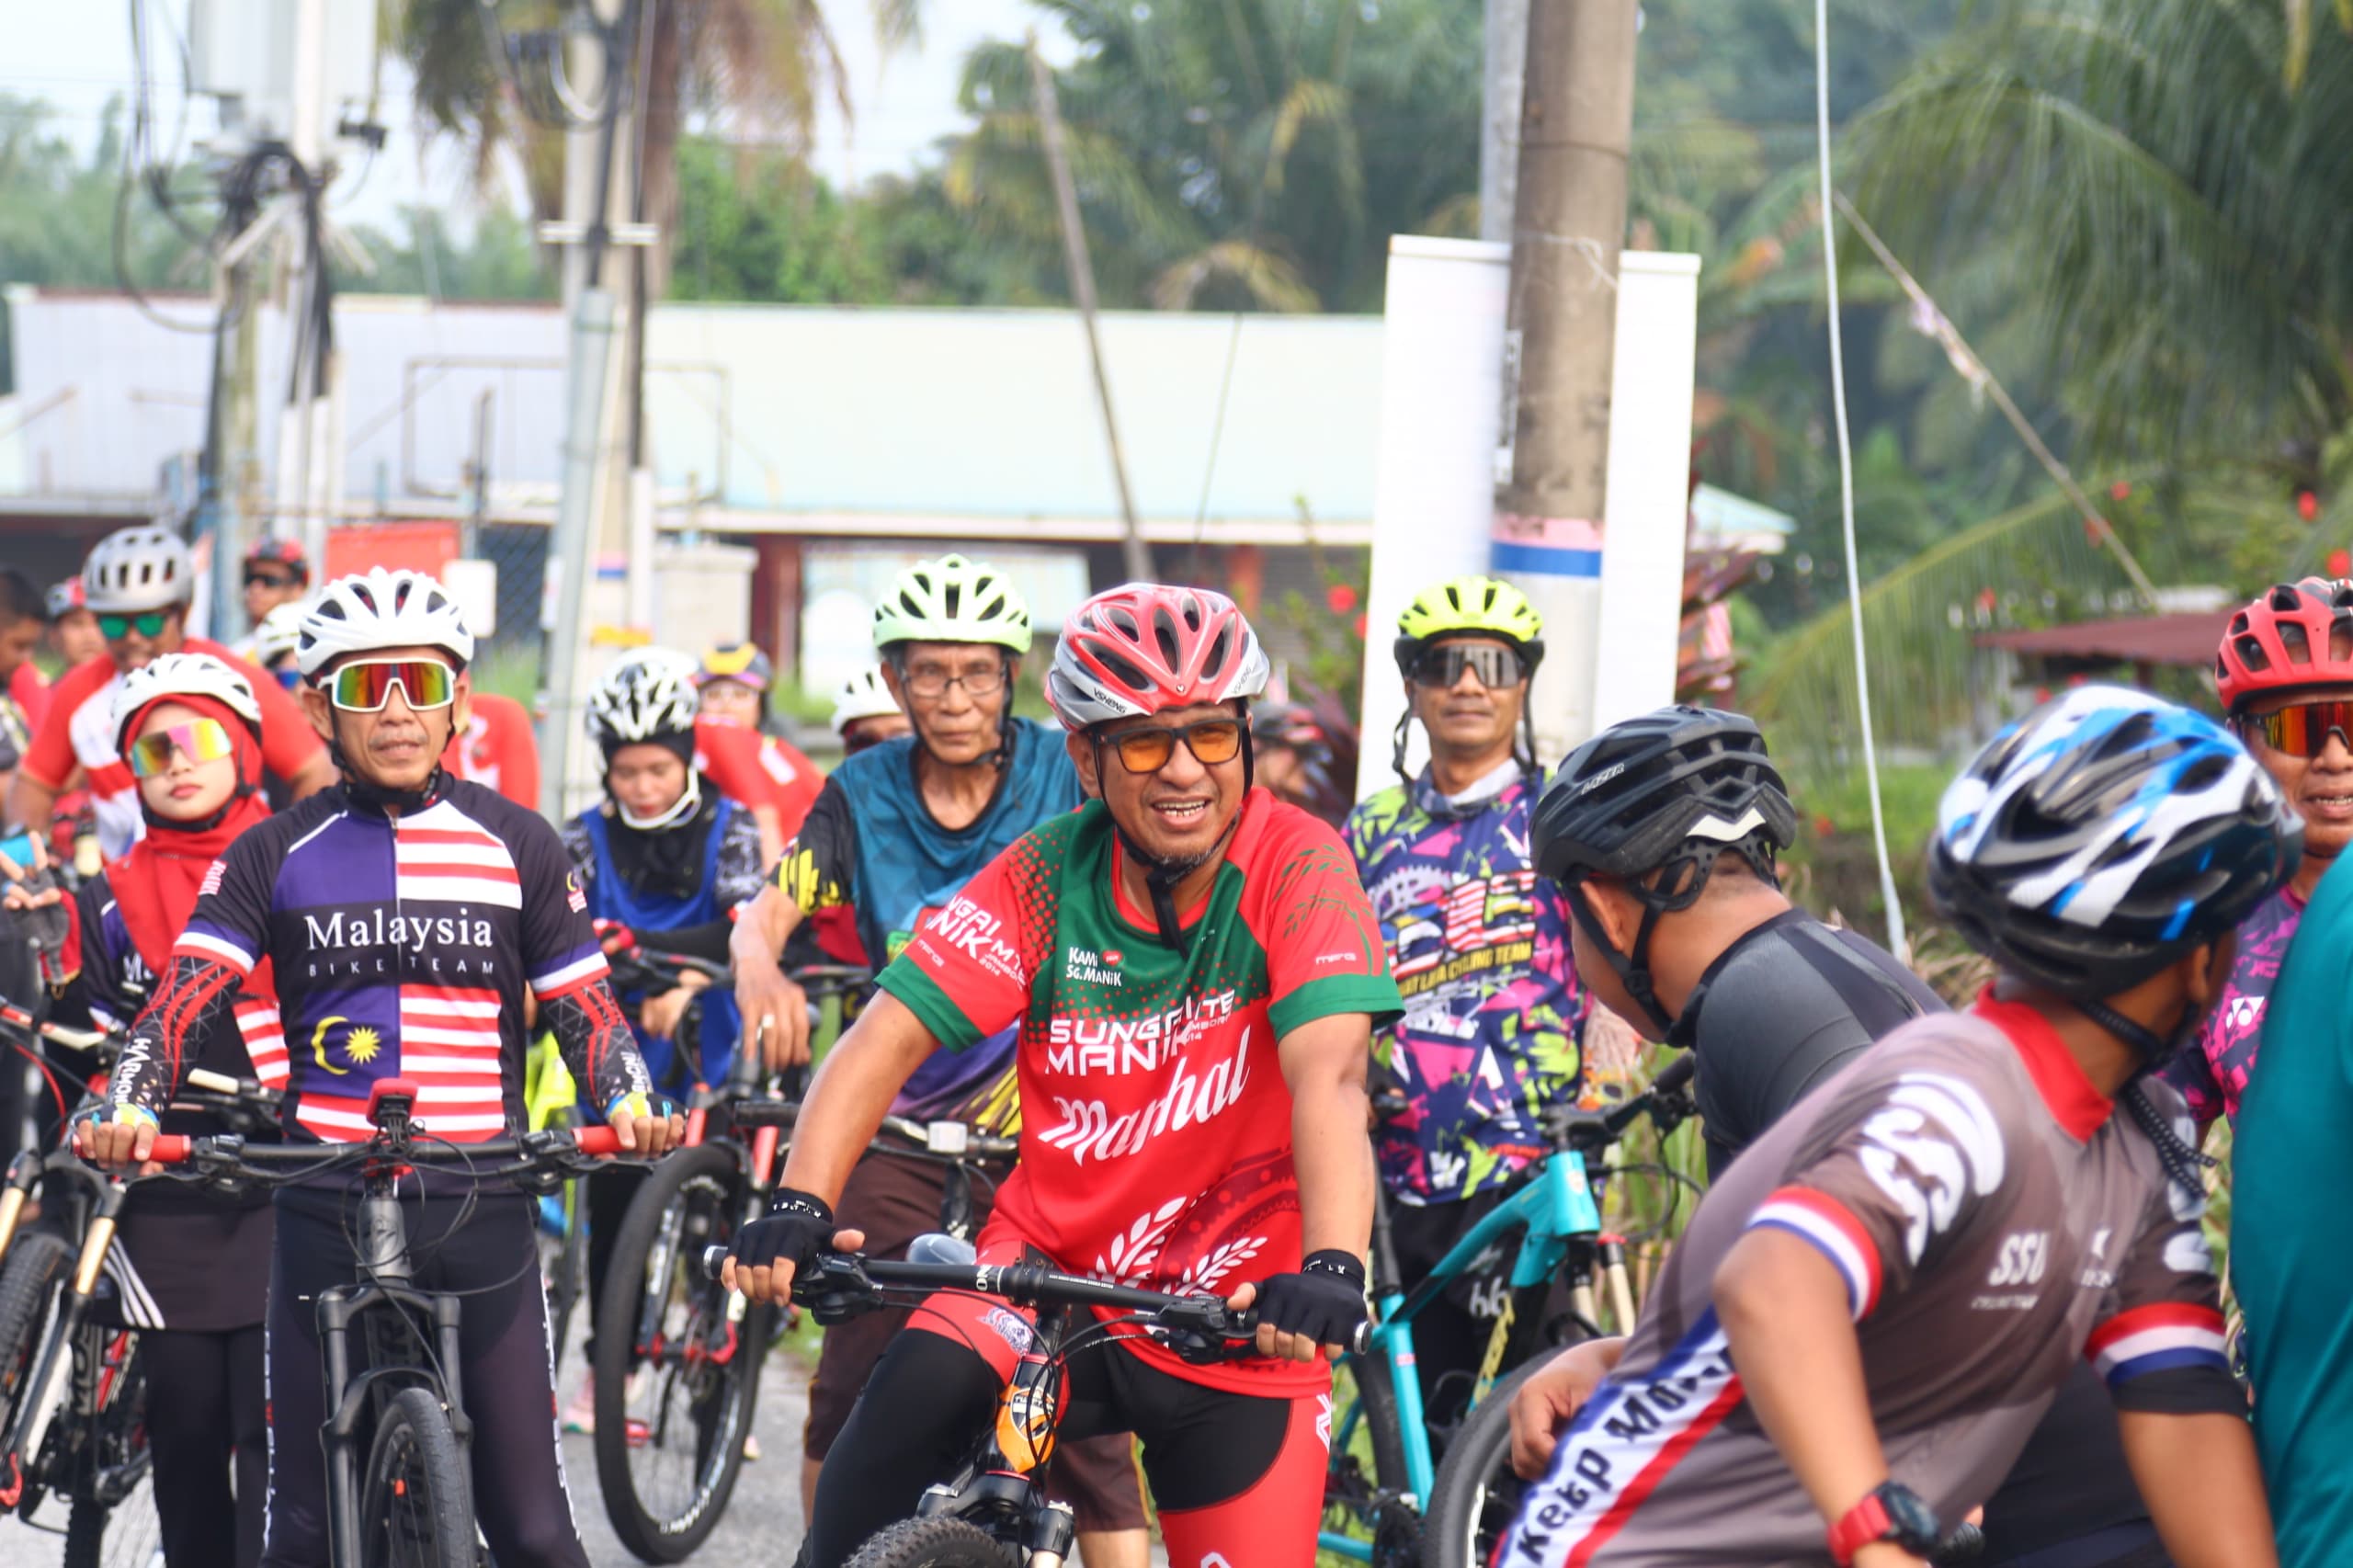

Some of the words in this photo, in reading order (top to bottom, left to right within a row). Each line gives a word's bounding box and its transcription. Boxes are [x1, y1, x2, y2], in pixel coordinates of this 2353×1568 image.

[303, 907, 494, 953] Malaysia
[309, 959, 384, 977] BIKE
[410, 956, 494, 974] TEAM
[1495, 940, 1532, 966] TEAM
[1517, 1448, 1614, 1567] Keep
